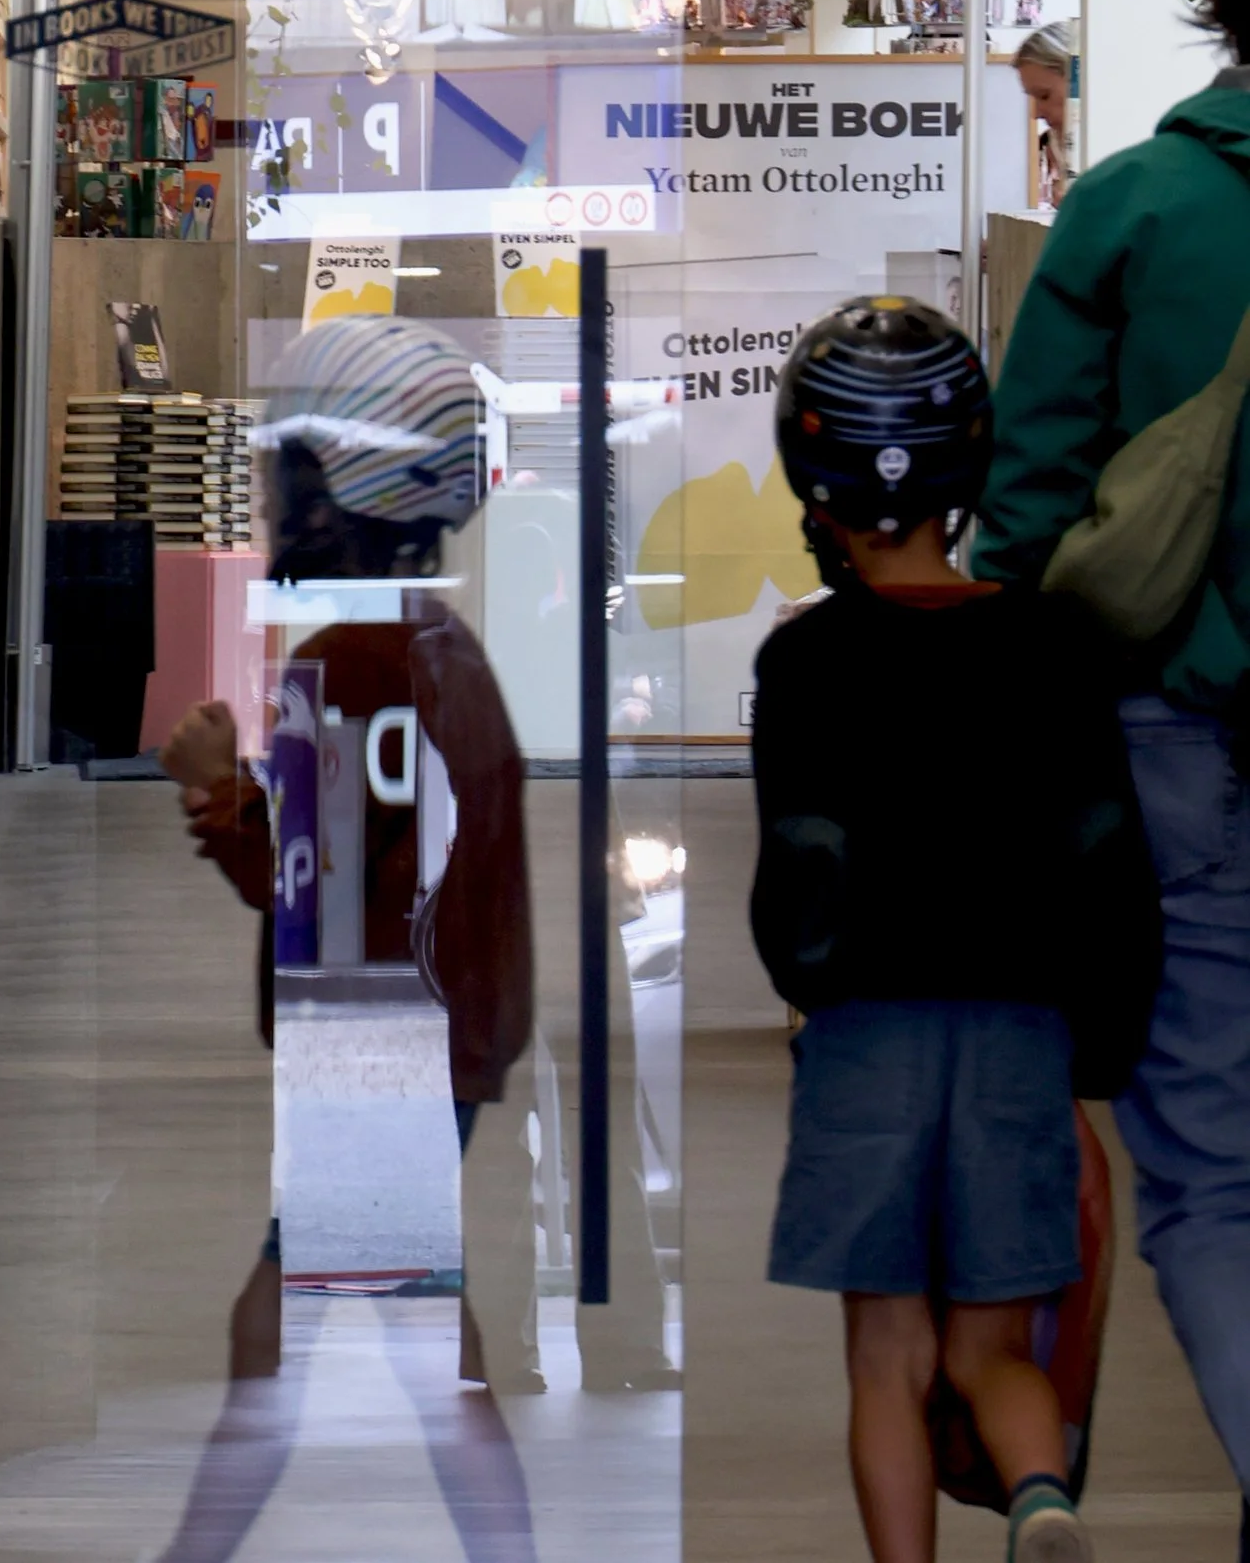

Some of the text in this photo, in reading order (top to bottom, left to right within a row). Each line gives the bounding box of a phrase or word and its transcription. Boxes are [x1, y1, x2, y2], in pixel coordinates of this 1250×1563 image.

[45, 0, 117, 40] BOOKS
[123, 0, 157, 31] WE
[164, 31, 226, 67] TRUST
[772, 83, 815, 97] HET
[606, 102, 819, 138] NIEUWE
[780, 147, 807, 158] van
[644, 164, 945, 200] Yotam Ottolenghi
[326, 245, 385, 256] Ottolenghi
[500, 234, 575, 244] EVEN SIMPEL
[317, 258, 391, 268] SIMPLE TOO
[663, 323, 802, 356] Ottoleng
